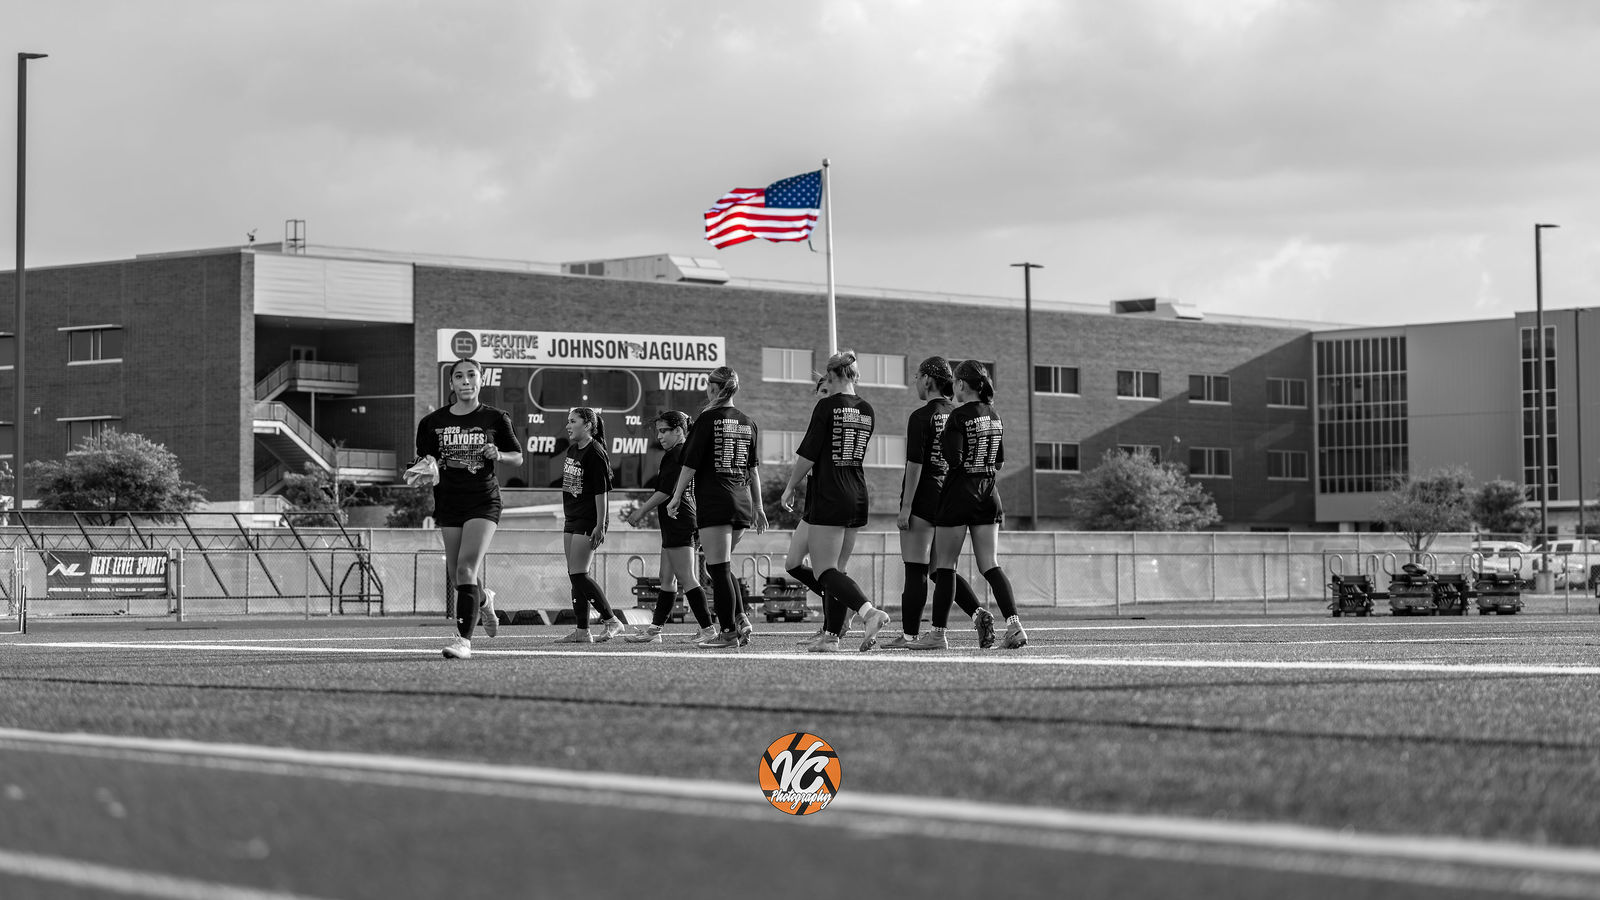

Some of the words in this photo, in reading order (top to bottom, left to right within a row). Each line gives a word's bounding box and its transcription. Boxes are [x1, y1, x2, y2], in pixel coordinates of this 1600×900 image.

[480, 333, 538, 349] EXECUTIVE
[548, 338, 629, 359] JOHNSON
[640, 341, 718, 362] JAGUARS
[481, 368, 502, 387] ME
[659, 372, 709, 391] VISITO
[528, 414, 544, 423] TOL
[625, 416, 642, 425] TOL
[443, 426, 461, 435] 2026
[832, 408, 843, 460] PLAYOFFS
[443, 433, 485, 446] PLAYOFFS
[527, 436, 556, 453] QTR
[612, 438, 648, 454] DWN
[714, 419, 723, 468] PLAYOFFS
[90, 556, 112, 575] NEXT
[112, 556, 135, 575] LEVEL
[136, 556, 167, 575] SPORTS
